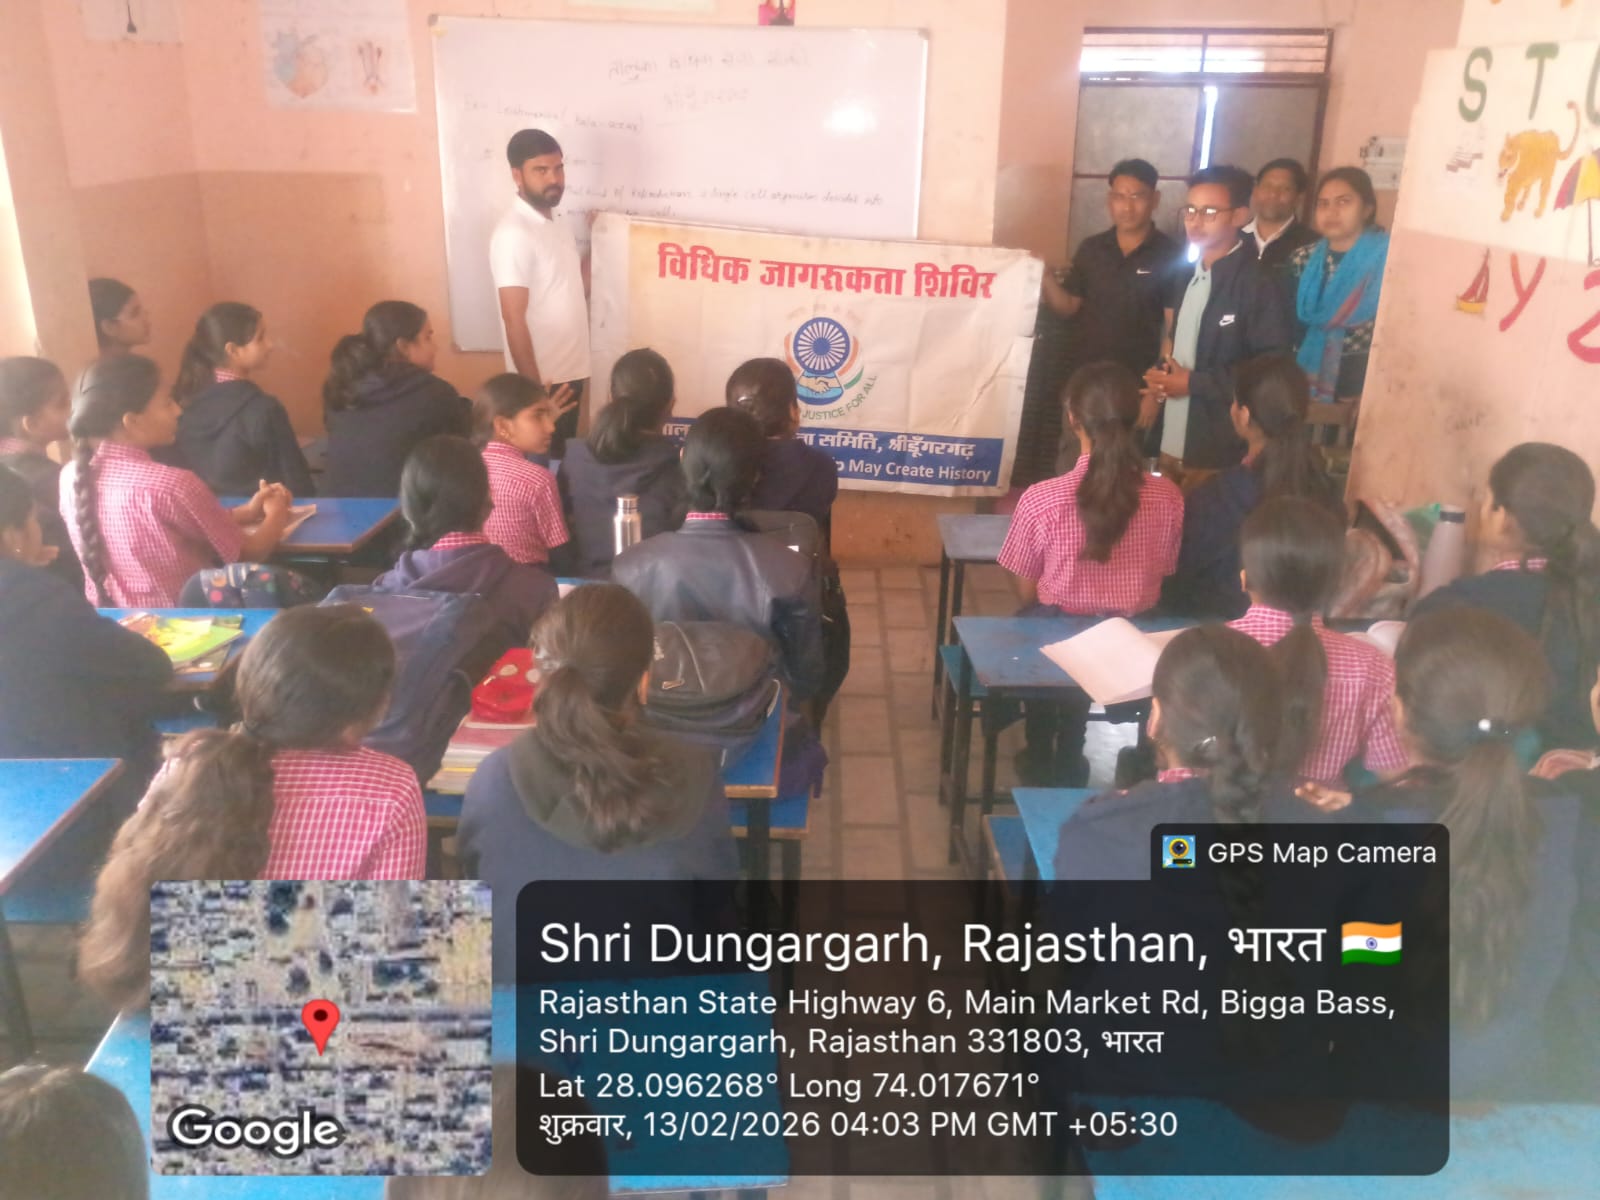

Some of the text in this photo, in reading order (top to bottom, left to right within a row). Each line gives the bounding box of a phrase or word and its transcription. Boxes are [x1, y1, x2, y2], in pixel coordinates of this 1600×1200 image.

[1458, 46, 1493, 122] S
[1525, 42, 1560, 120] T
[657, 242, 752, 285] विधिक
[914, 262, 998, 299] शिविर
[802, 375, 878, 420] JUSTICE FOR ALL
[818, 431, 883, 453] समिति,
[848, 459, 882, 477] May
[885, 462, 934, 478] Create
[938, 466, 991, 483] History
